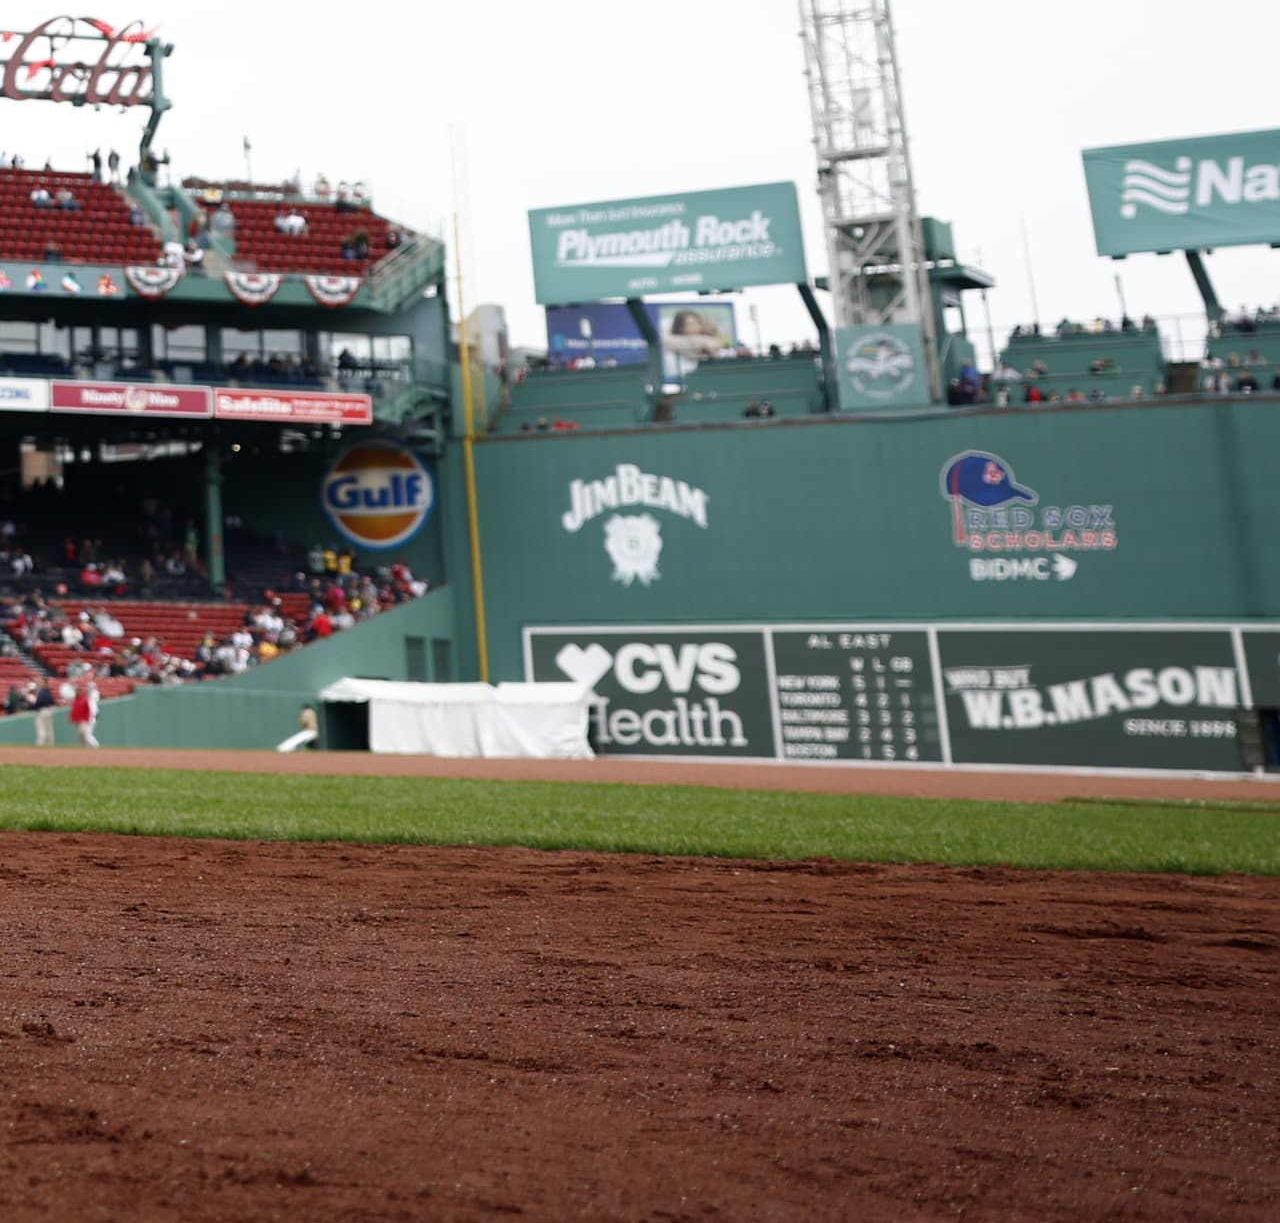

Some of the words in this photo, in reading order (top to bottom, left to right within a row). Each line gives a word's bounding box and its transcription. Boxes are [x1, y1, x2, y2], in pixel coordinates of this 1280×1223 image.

[557, 219, 691, 264] Plymouth
[696, 211, 772, 247] Rock
[674, 241, 776, 266] assurance
[219, 395, 292, 413] Safelite
[327, 474, 422, 508] Gulf
[562, 477, 618, 533] JIM
[615, 463, 710, 529] BEAM
[968, 507, 1035, 530] RED
[1042, 504, 1116, 529] SOX
[969, 530, 1118, 552] SCHOLARS
[969, 557, 1050, 581] BIDMC
[807, 633, 833, 649] AL
[839, 633, 890, 649] EAST
[614, 643, 742, 694] CVS
[872, 656, 886, 673] L
[1124, 718, 1187, 737] SINCE
